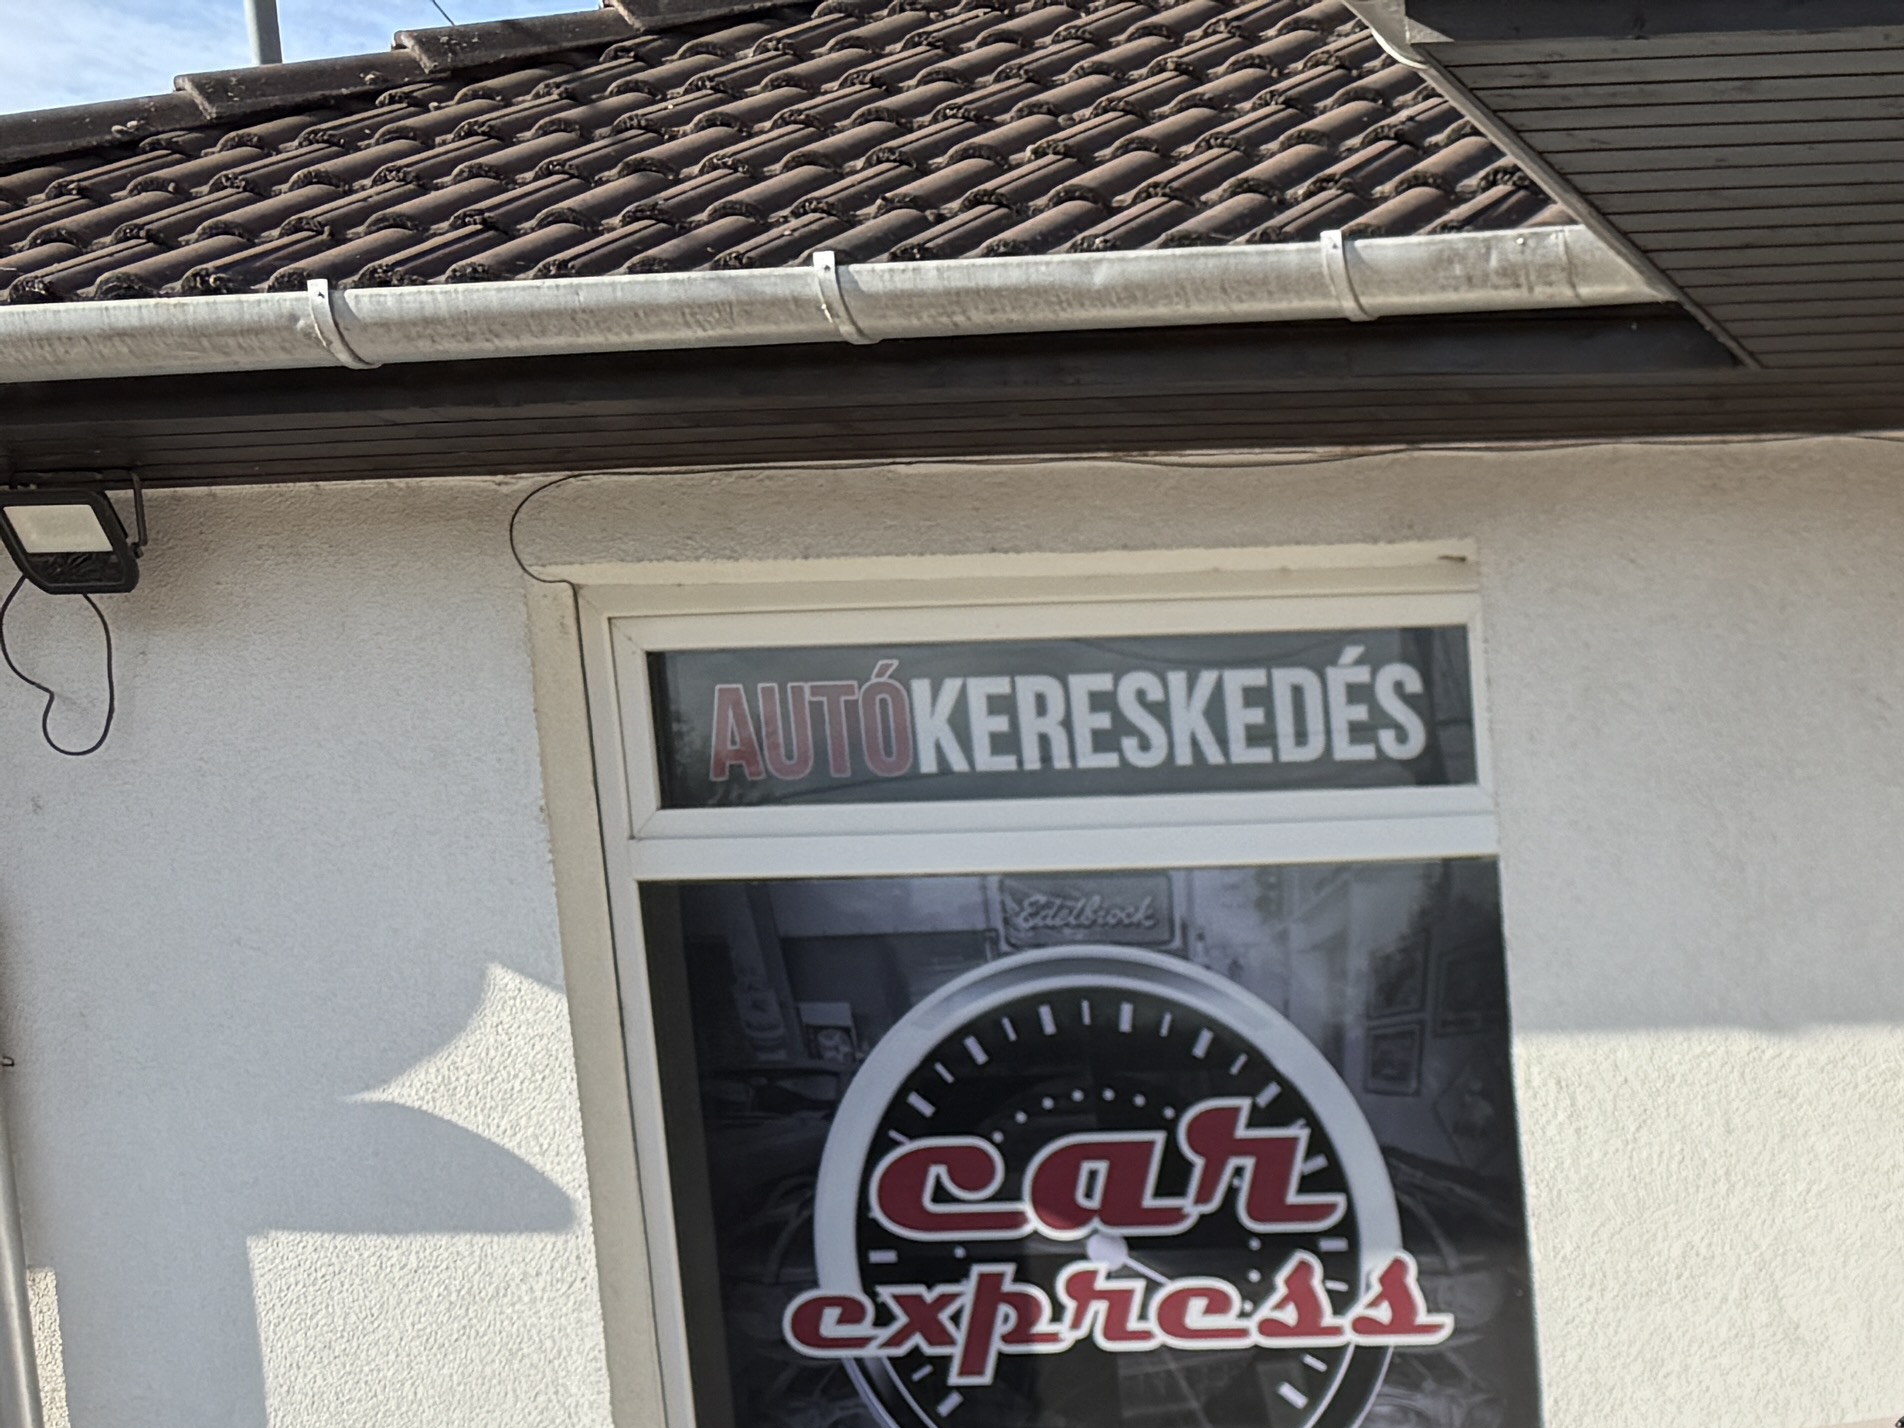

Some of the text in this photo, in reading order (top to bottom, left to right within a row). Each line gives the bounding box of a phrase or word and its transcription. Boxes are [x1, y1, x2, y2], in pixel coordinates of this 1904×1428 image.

[710, 647, 1427, 782] AUTÓKERESKEDÉS
[1020, 894, 1158, 930] Edelbrock
[871, 1098, 1348, 1243] car
[784, 1252, 1455, 1386] express
